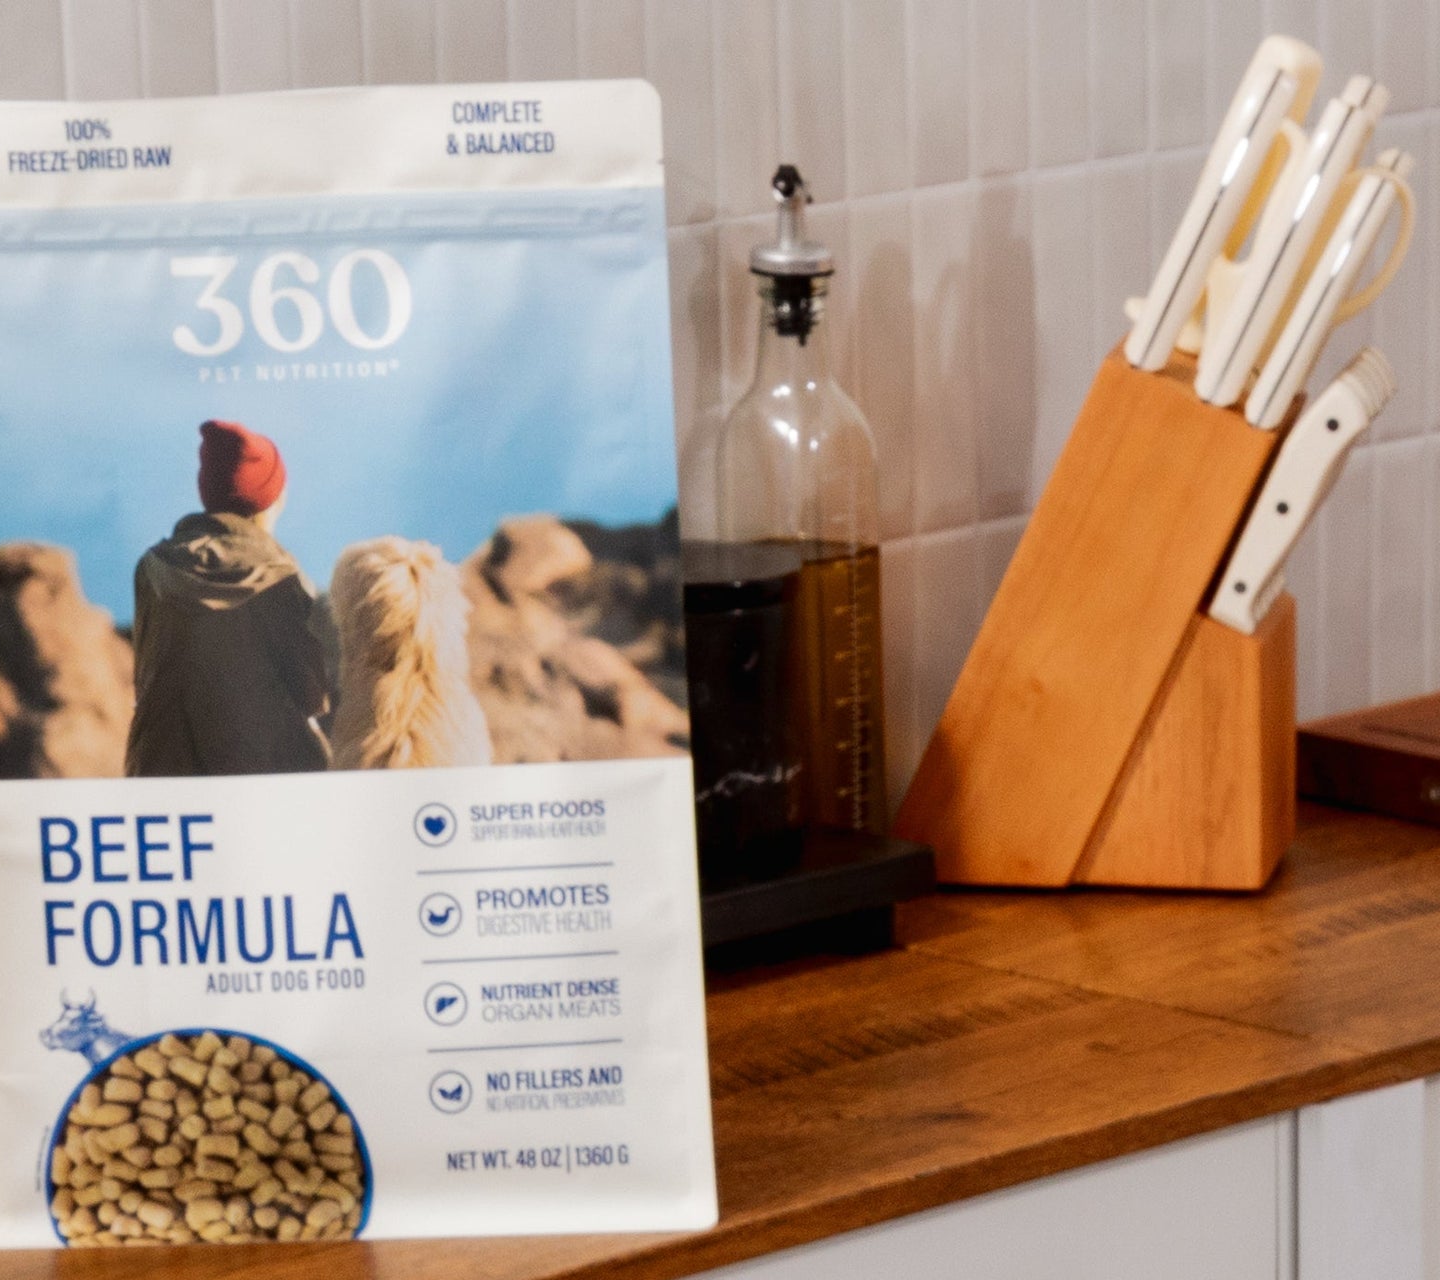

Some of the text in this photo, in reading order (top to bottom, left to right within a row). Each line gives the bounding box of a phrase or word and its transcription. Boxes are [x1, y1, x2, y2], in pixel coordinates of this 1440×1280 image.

[452, 100, 543, 123] COMPLETE
[64, 119, 112, 141] 100%
[447, 131, 555, 155] & BALANCED
[7, 145, 172, 174] FREEZE-DRIED RAW
[169, 249, 412, 357] 360
[198, 365, 241, 384] PET
[470, 799, 606, 822] SUPER FOODS
[39, 814, 214, 884] BEEF
[476, 884, 610, 910] PROMOTES
[44, 893, 365, 967] FORMULA
[556, 910, 612, 934] HEALTH
[206, 968, 366, 994] ADULT DOG FOOD
[481, 978, 620, 1002] NUTRIENT DENSE
[482, 998, 621, 1024] ORGAN MEATS
[487, 1065, 623, 1092] NO FILLERS AND
[447, 1144, 629, 1171] NET WT. 48 OZ 1360 G
